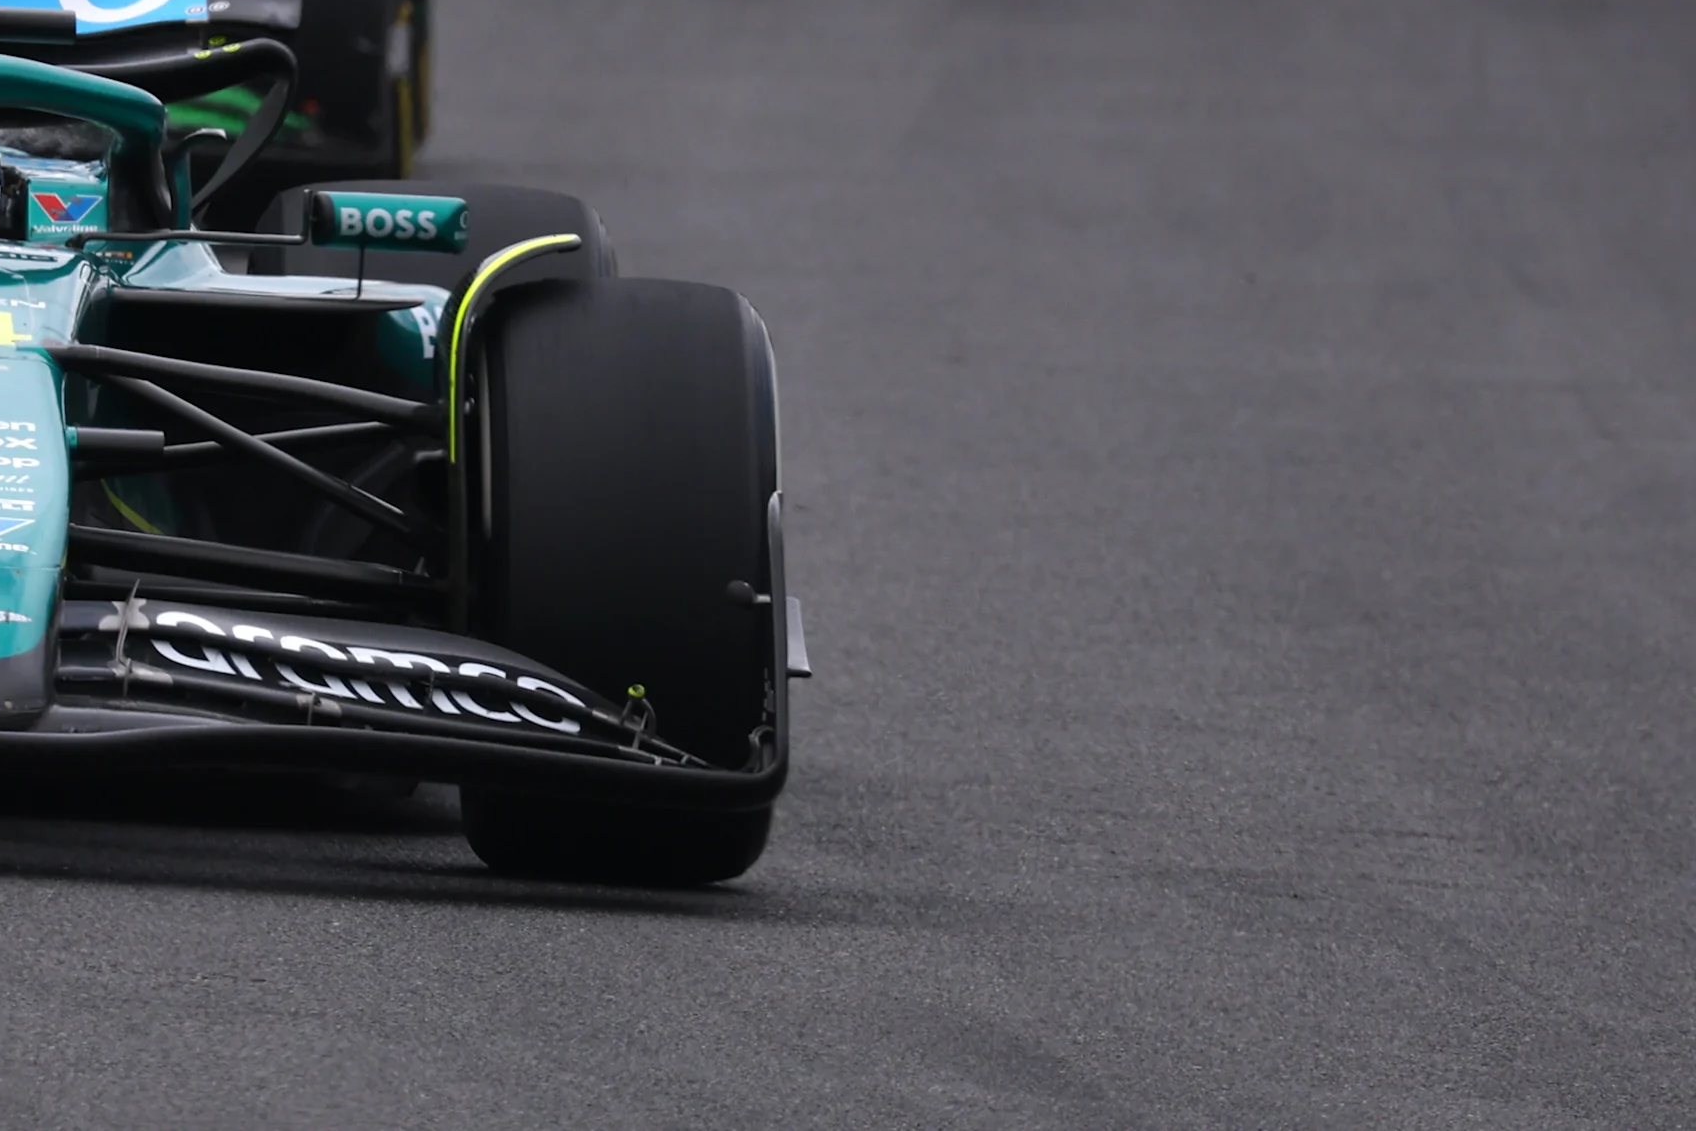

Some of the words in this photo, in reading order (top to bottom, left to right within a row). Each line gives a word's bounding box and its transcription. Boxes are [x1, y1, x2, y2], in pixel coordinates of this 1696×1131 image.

[32, 224, 98, 234] Valvoline
[340, 207, 437, 240] BOSS
[150, 610, 587, 734] aramco
